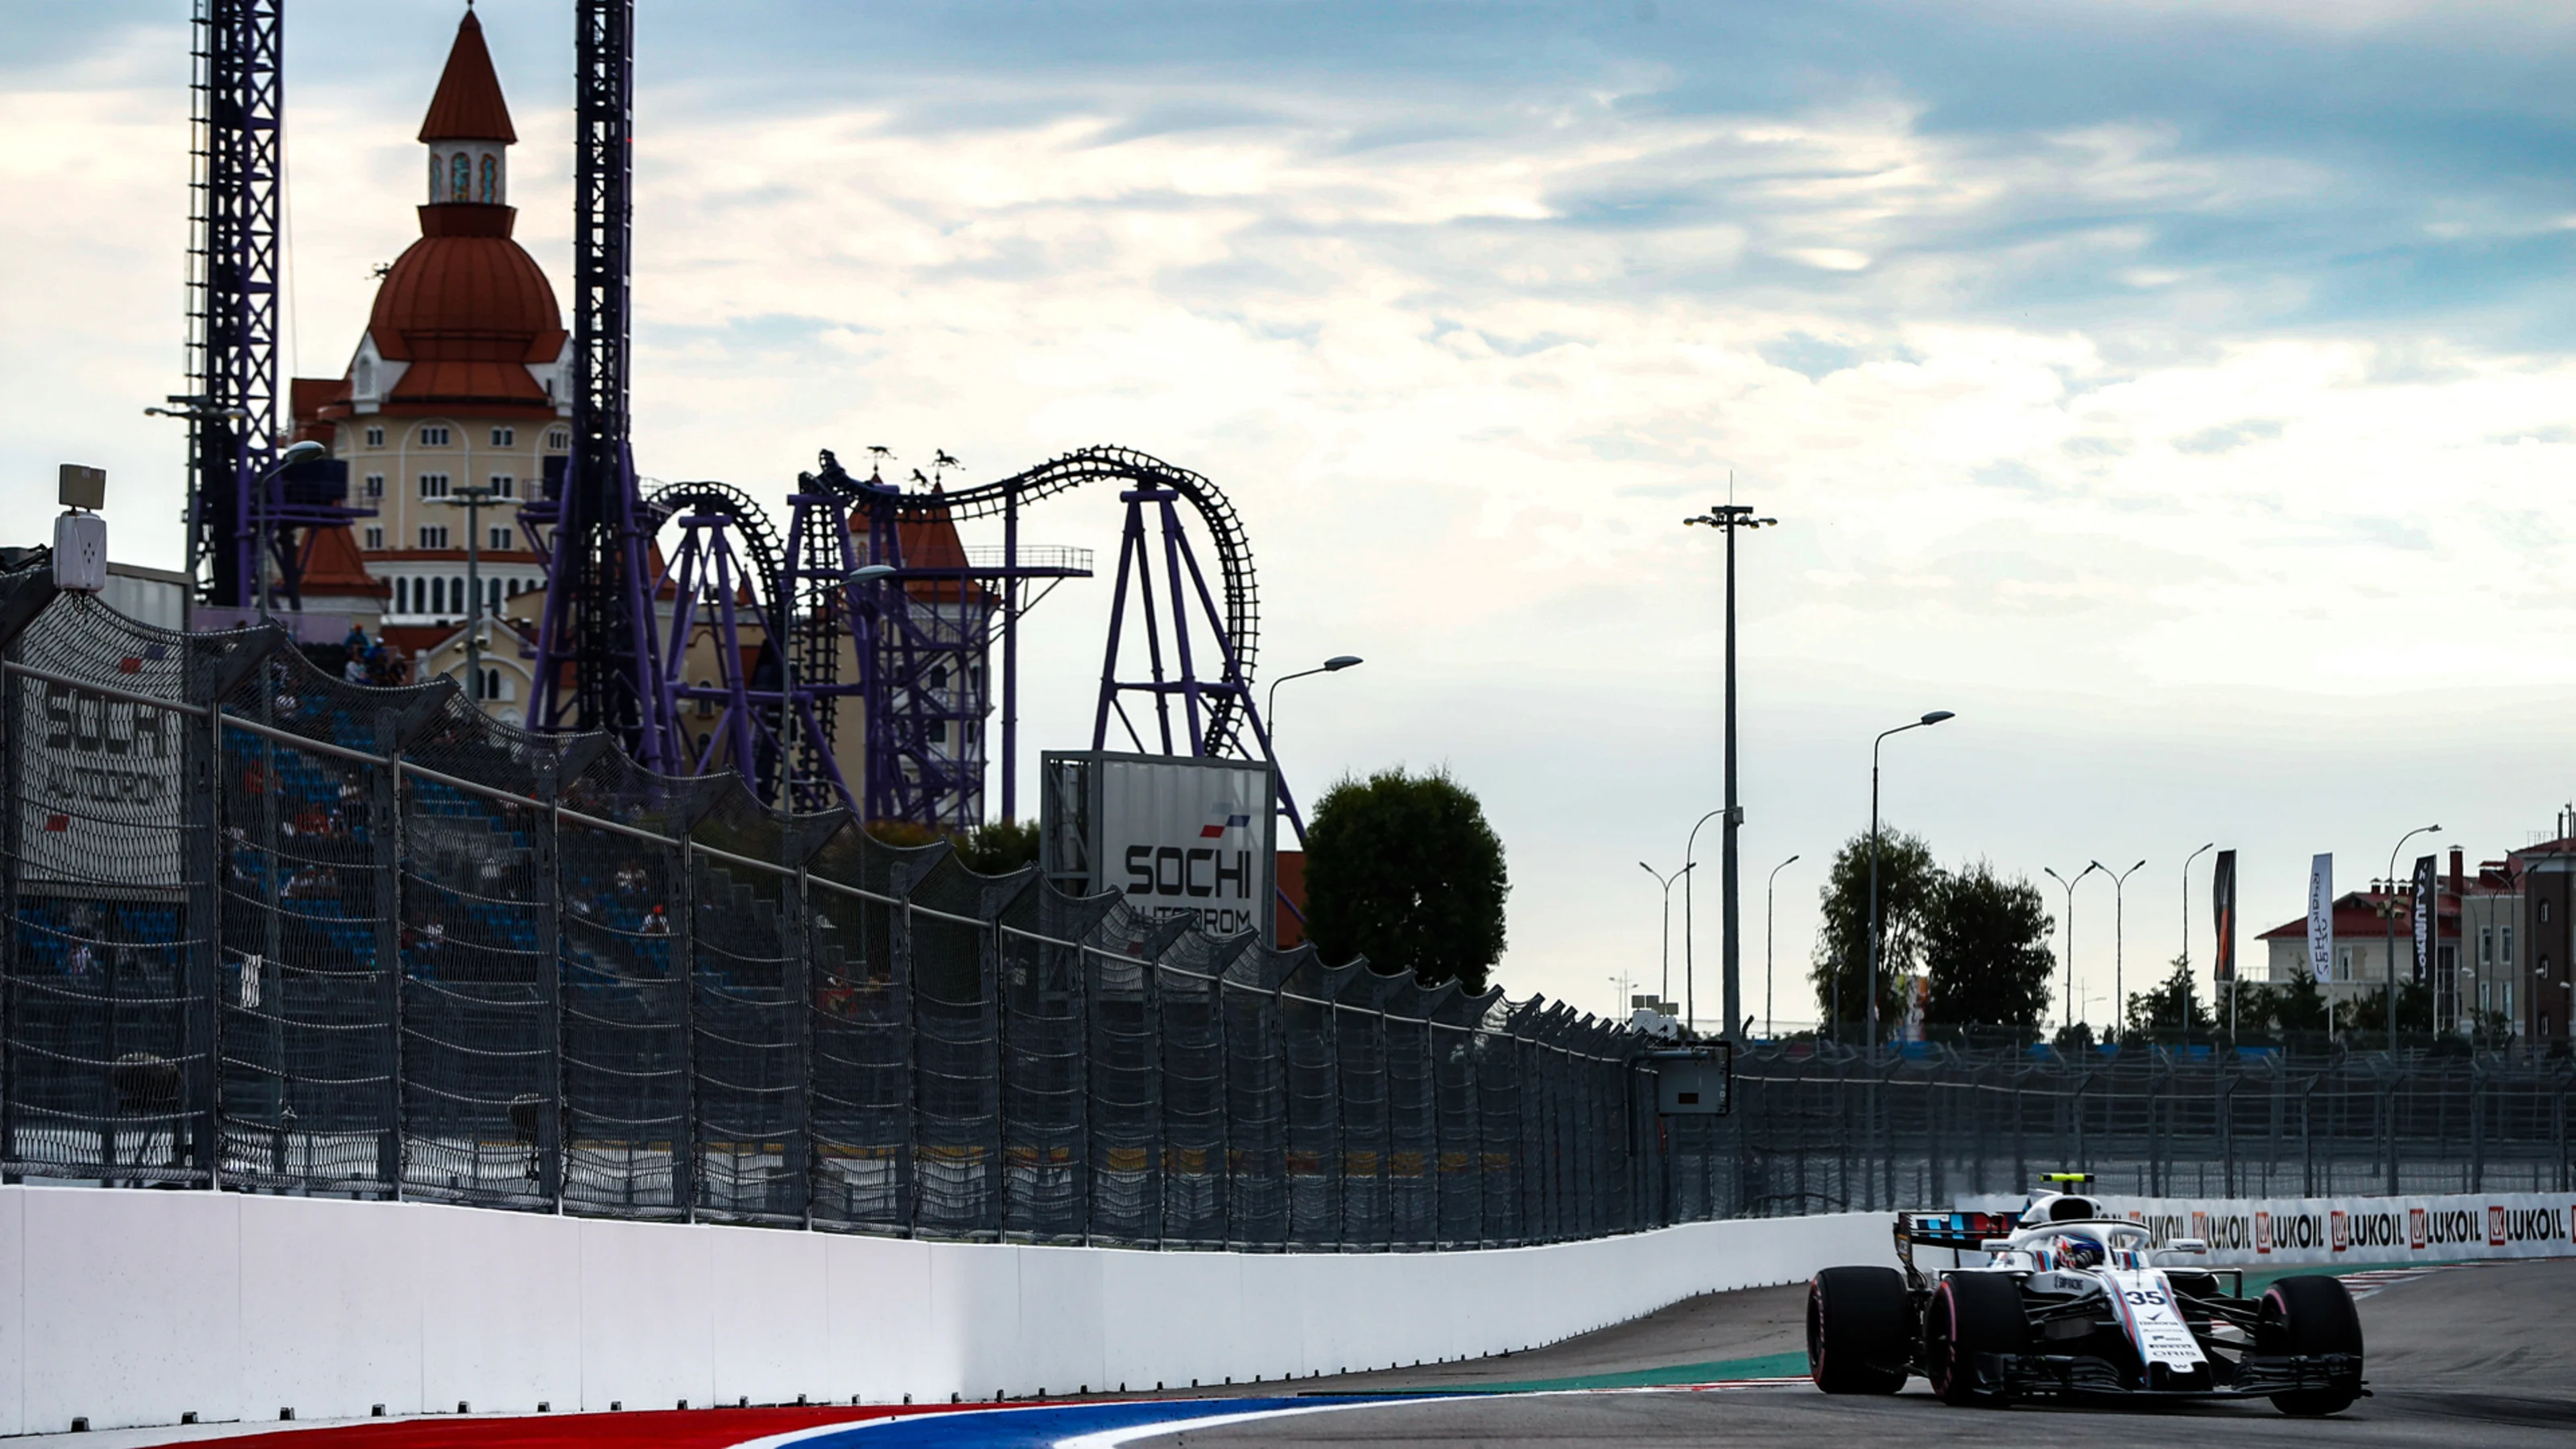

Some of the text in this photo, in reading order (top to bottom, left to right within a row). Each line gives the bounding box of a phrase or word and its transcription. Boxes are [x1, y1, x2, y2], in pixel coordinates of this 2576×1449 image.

[1125, 845, 1251, 899] SOCHI
[2207, 1215, 2252, 1249] LUKOIL
[2270, 1214, 2324, 1249] LUKOIL
[2347, 1213, 2405, 1246] LUKOIL
[2425, 1210, 2481, 1243] LUKOIL
[2505, 1208, 2566, 1241] LUKOIL
[2125, 1291, 2167, 1306] 35
